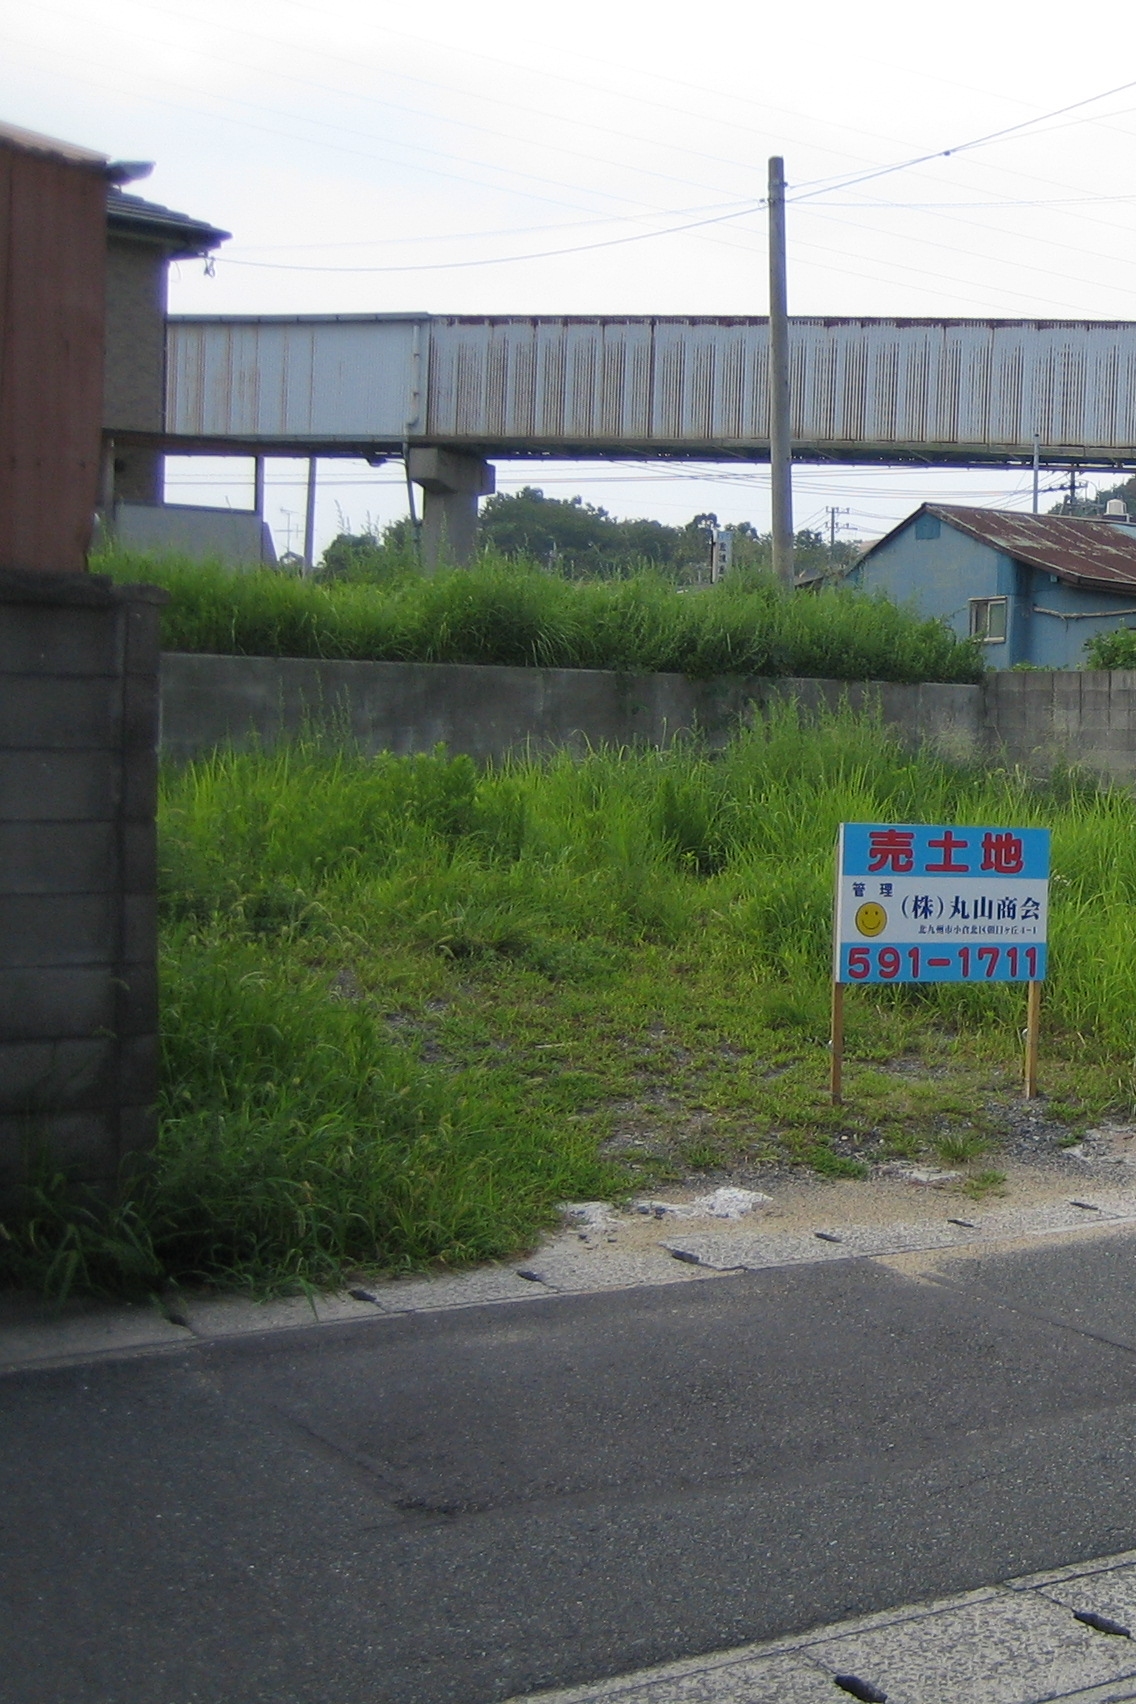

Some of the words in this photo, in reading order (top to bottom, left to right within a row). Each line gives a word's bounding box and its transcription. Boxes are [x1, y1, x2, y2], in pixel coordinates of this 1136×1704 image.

[867, 829, 1024, 874] 売土地
[852, 882, 893, 898] 管理
[848, 946, 1037, 979] 591-1711
